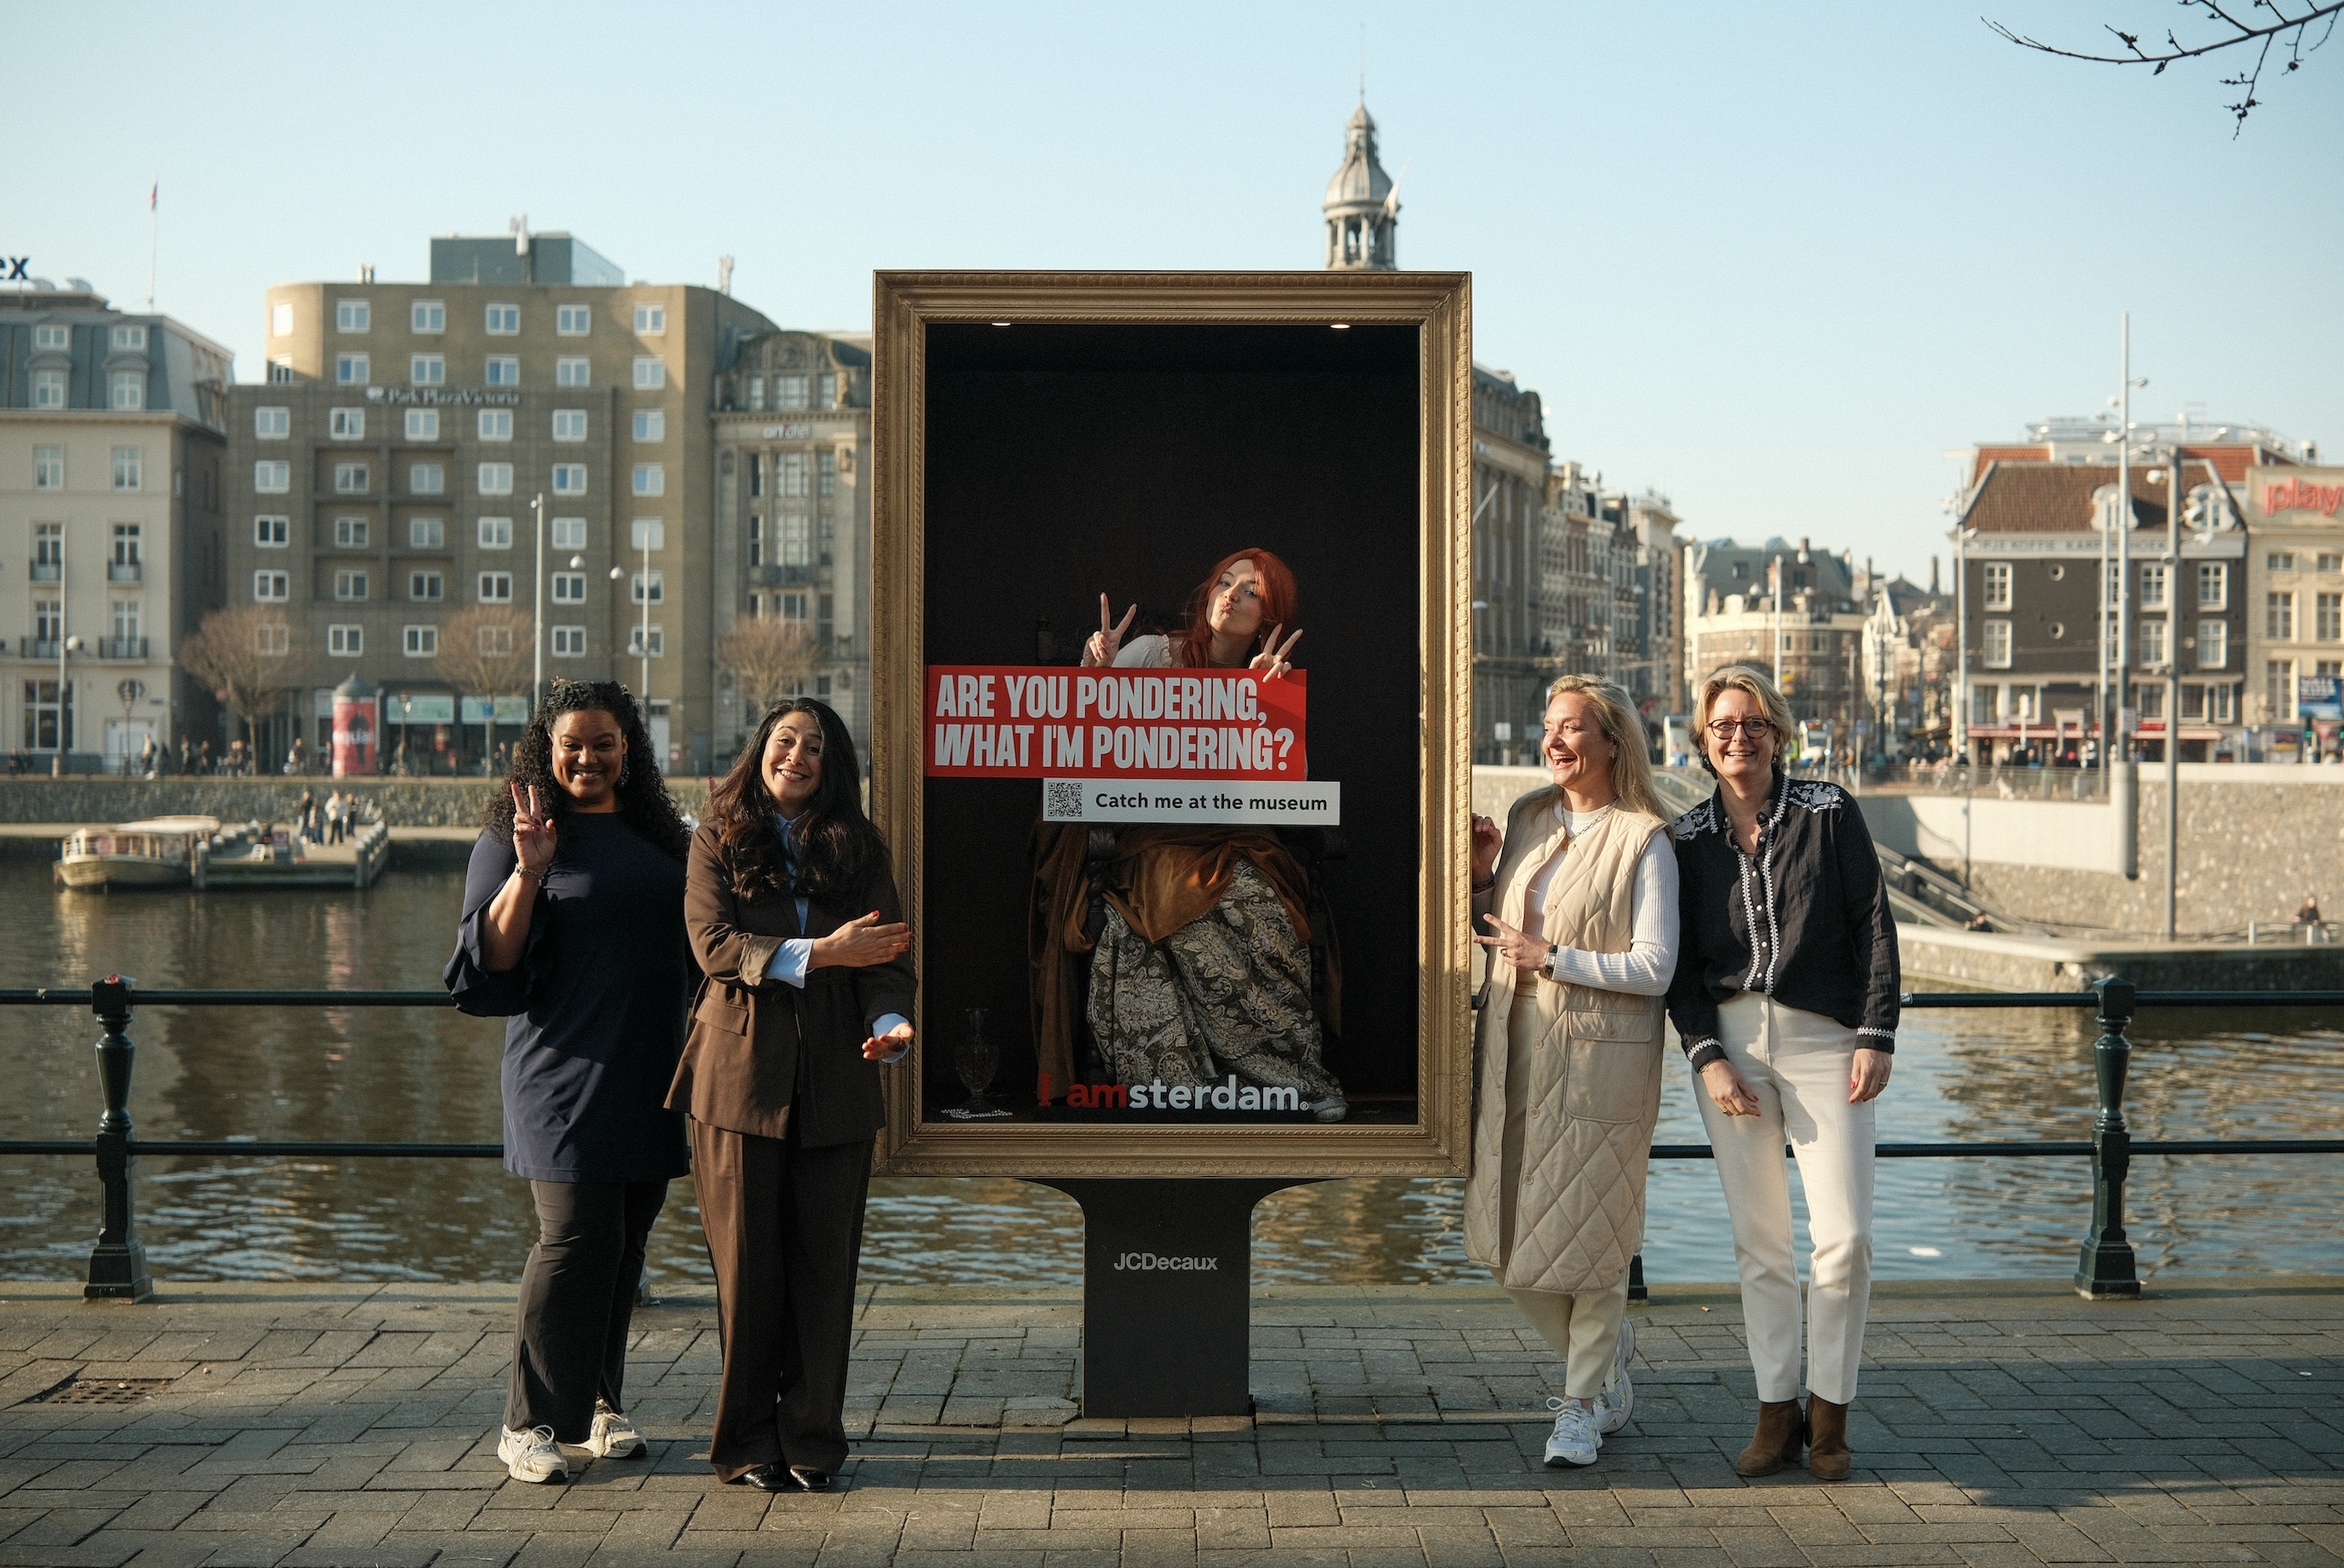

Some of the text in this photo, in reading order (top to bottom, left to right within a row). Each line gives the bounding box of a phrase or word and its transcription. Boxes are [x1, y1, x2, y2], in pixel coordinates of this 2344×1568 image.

[2263, 477, 2344, 517] play
[936, 674, 1267, 726] ARE YOU PONDERING,
[935, 724, 1294, 771] WHAT I'M PONDERING?
[1095, 792, 1328, 811] Catch me at the museum
[1038, 1073, 1052, 1106] I
[1113, 1252, 1218, 1270] JCDecaux
